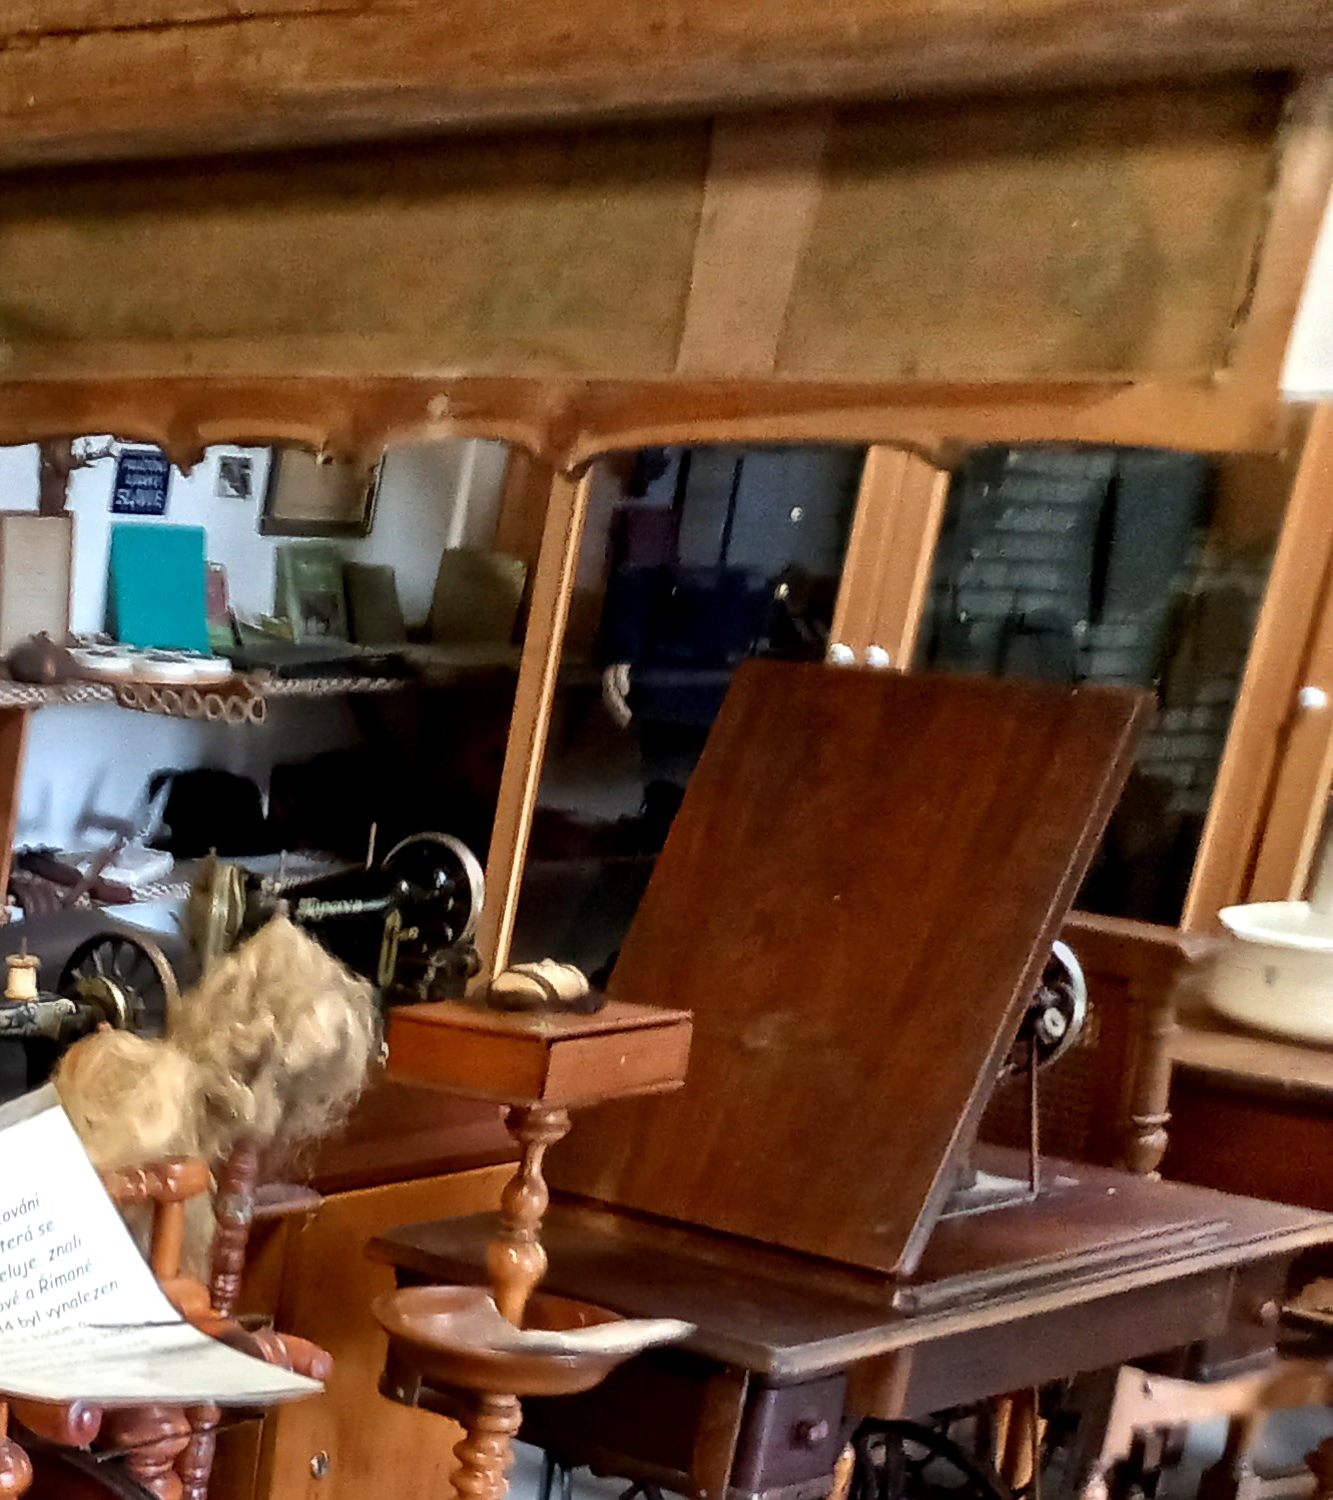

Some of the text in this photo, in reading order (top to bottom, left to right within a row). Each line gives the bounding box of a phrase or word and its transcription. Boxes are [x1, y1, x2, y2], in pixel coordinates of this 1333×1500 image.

[37, 1218, 55, 1238] se
[47, 1233, 82, 1263] znali
[25, 1287, 36, 1300] a
[37, 1257, 93, 1295] Římané
[17, 1310, 42, 1329] byl
[44, 1279, 119, 1320] vynalezen
